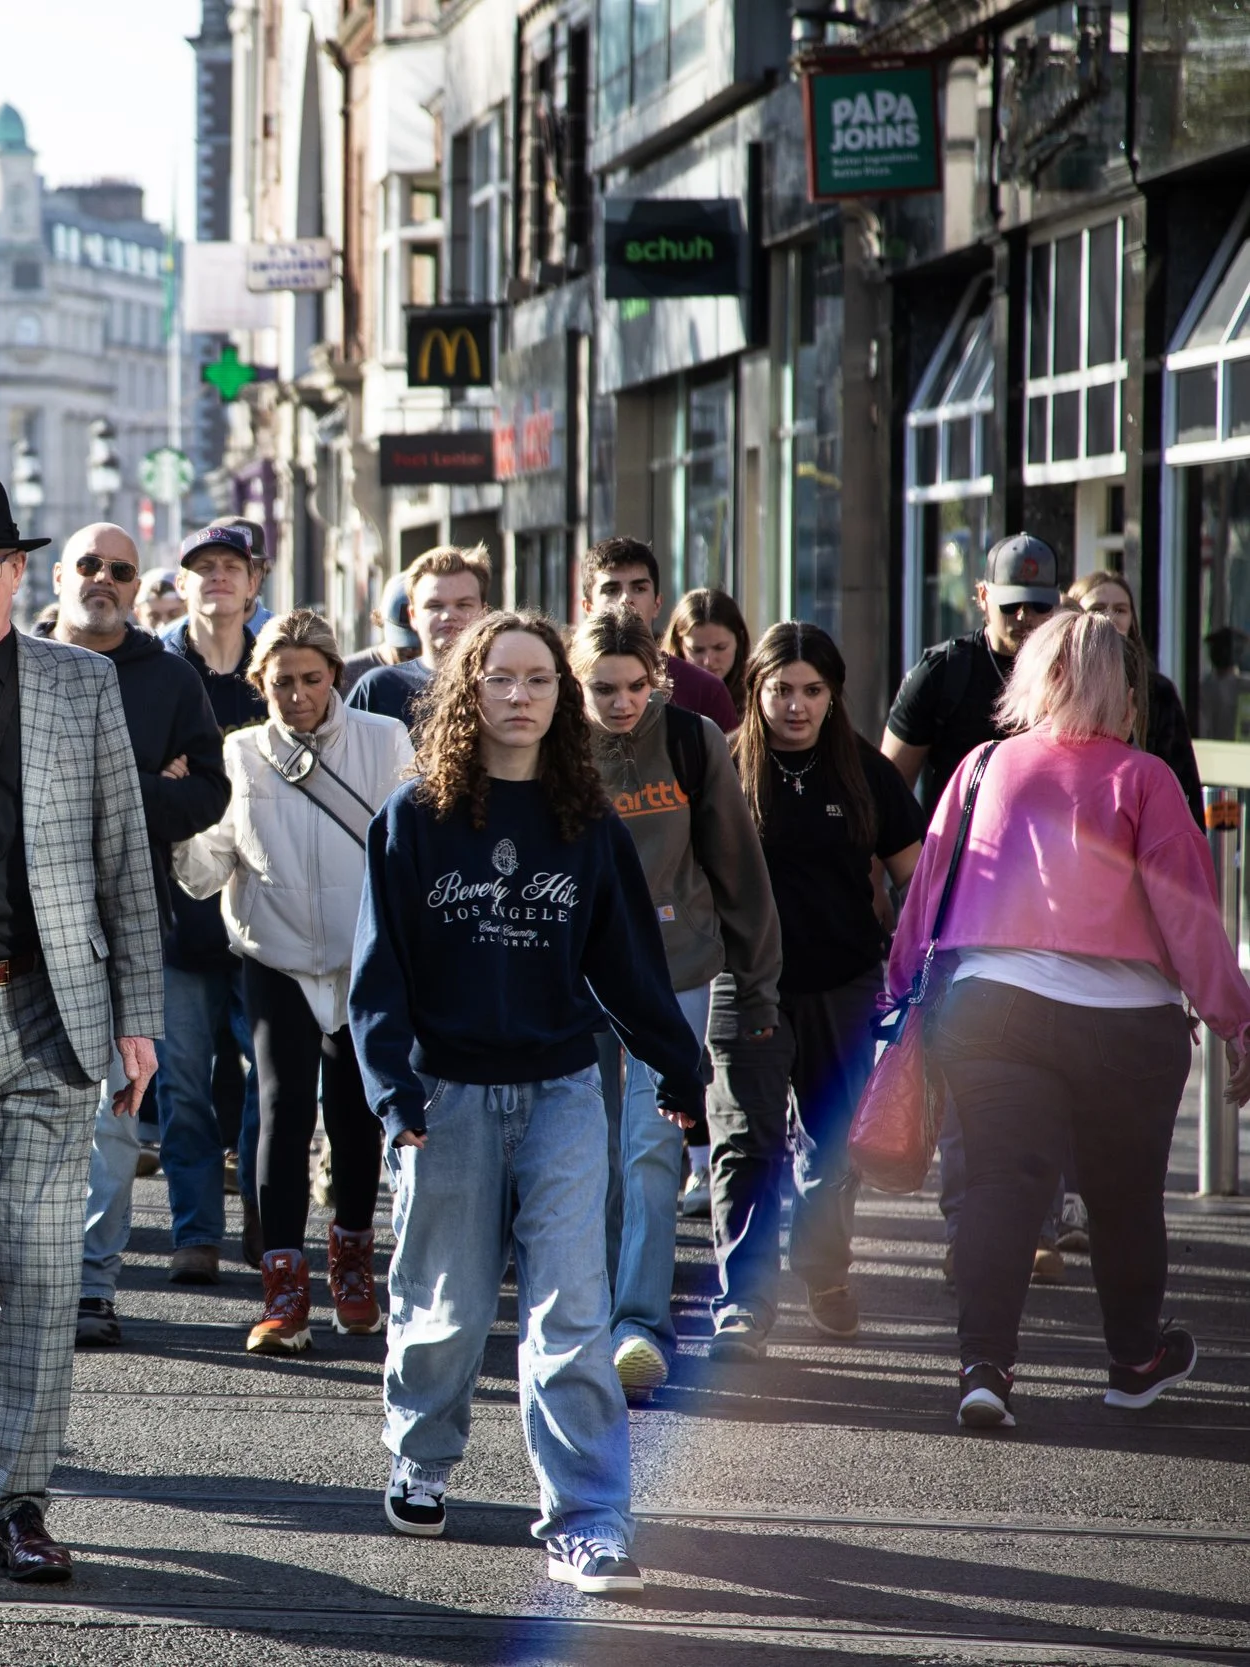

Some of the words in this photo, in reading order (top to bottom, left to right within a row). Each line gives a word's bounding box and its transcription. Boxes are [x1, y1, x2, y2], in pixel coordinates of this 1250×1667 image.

[830, 90, 918, 126] PAPA
[829, 124, 921, 153] JOHNS
[625, 235, 715, 262] schuh
[613, 780, 674, 812] artt
[427, 869, 510, 907] Beverly
[443, 904, 480, 923] LOS
[490, 904, 569, 923] ANGELE
[471, 935, 550, 948] CALORNIA
